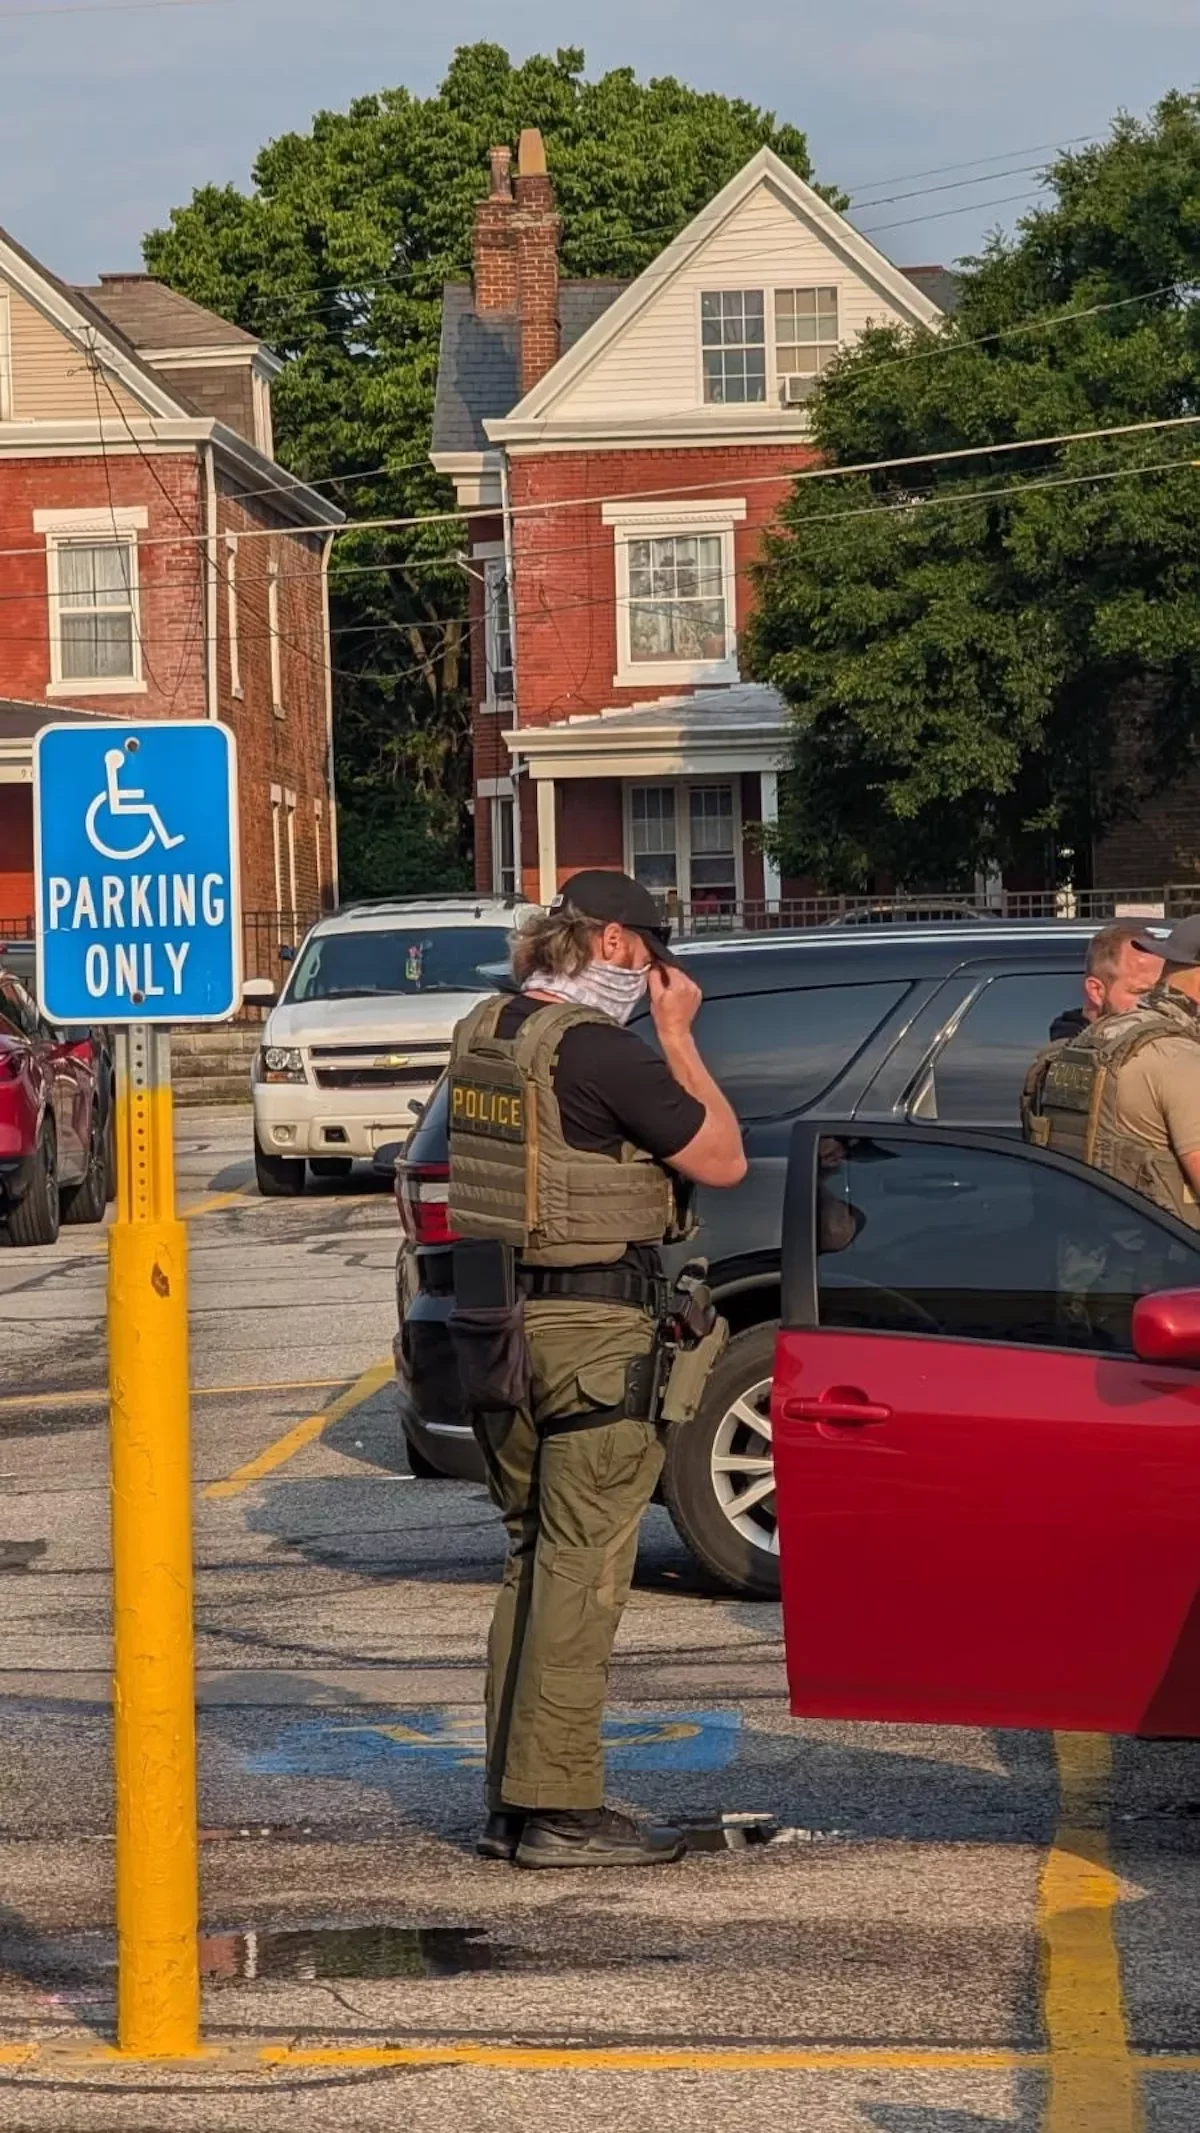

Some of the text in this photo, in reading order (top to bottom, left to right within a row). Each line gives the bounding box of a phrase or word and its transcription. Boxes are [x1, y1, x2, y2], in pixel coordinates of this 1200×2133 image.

[48, 873, 225, 930] PARKING
[85, 942, 191, 998] ONLY
[452, 1087, 522, 1127] POLICE
